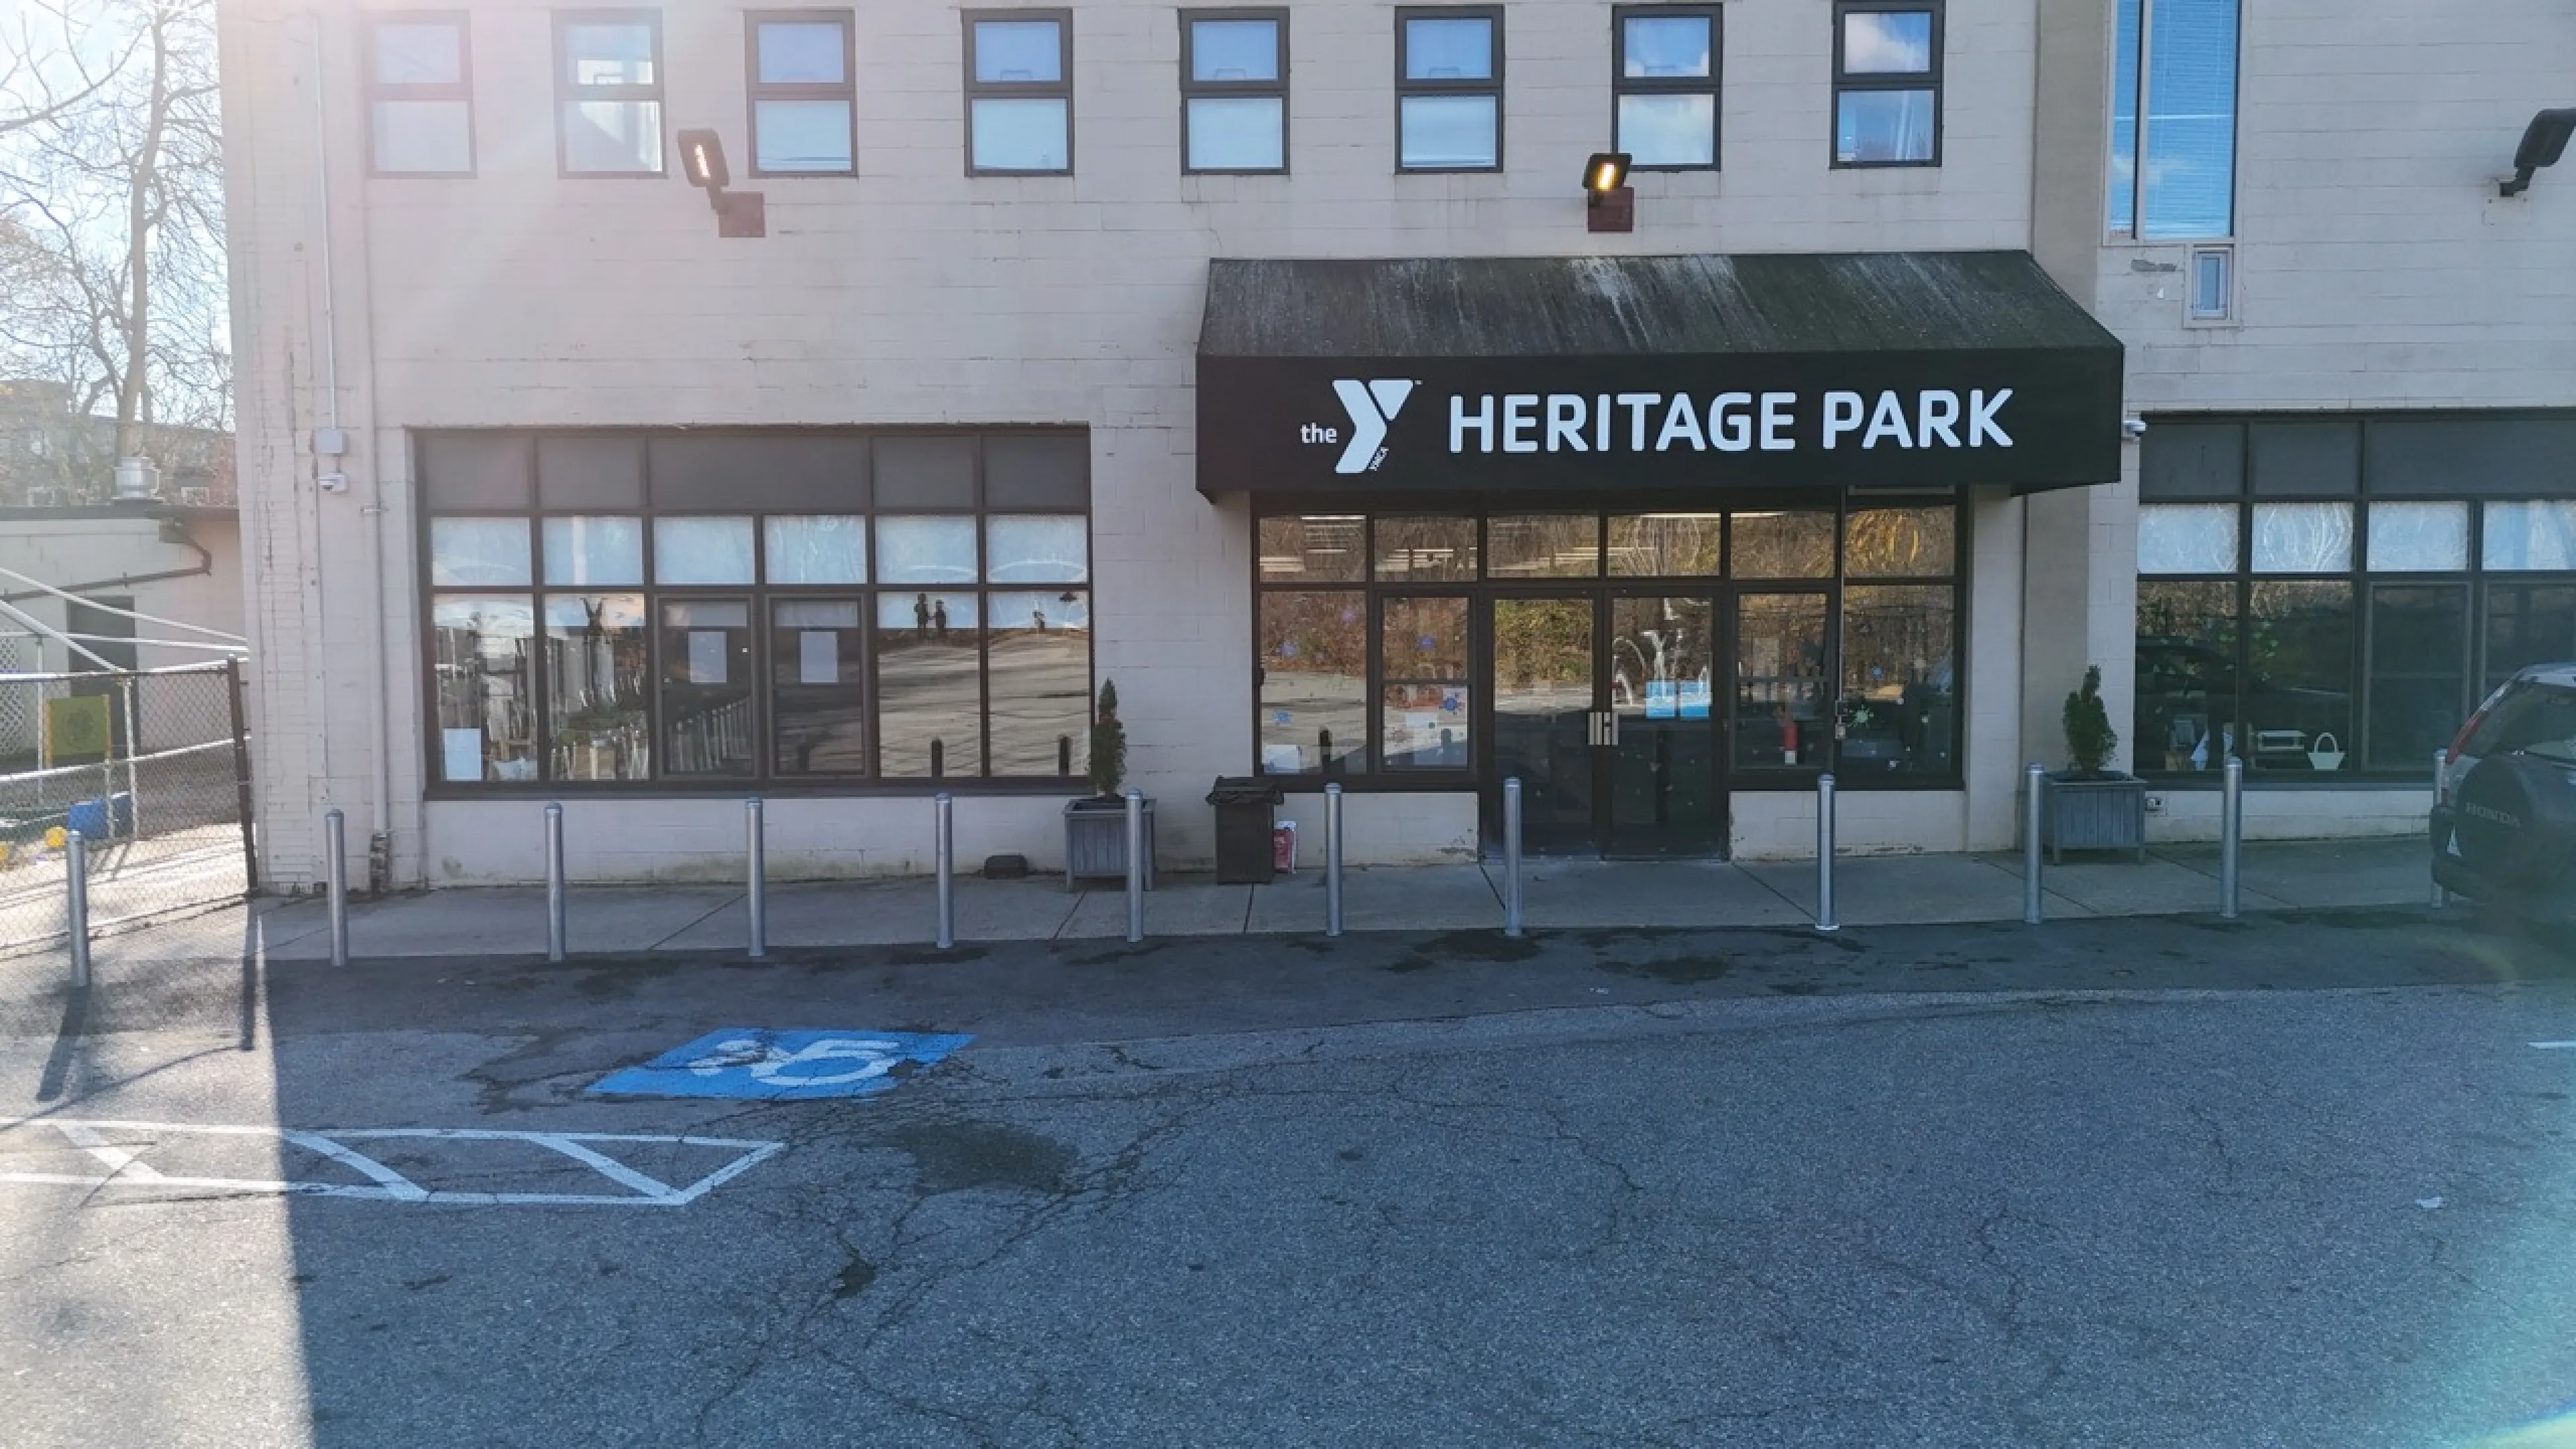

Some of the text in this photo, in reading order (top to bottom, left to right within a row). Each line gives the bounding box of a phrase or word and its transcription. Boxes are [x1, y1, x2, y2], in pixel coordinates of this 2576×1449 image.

[1300, 422, 1337, 443] the
[1450, 388, 2014, 453] HERITAGE PARK
[2465, 802, 2521, 828] HONDA
